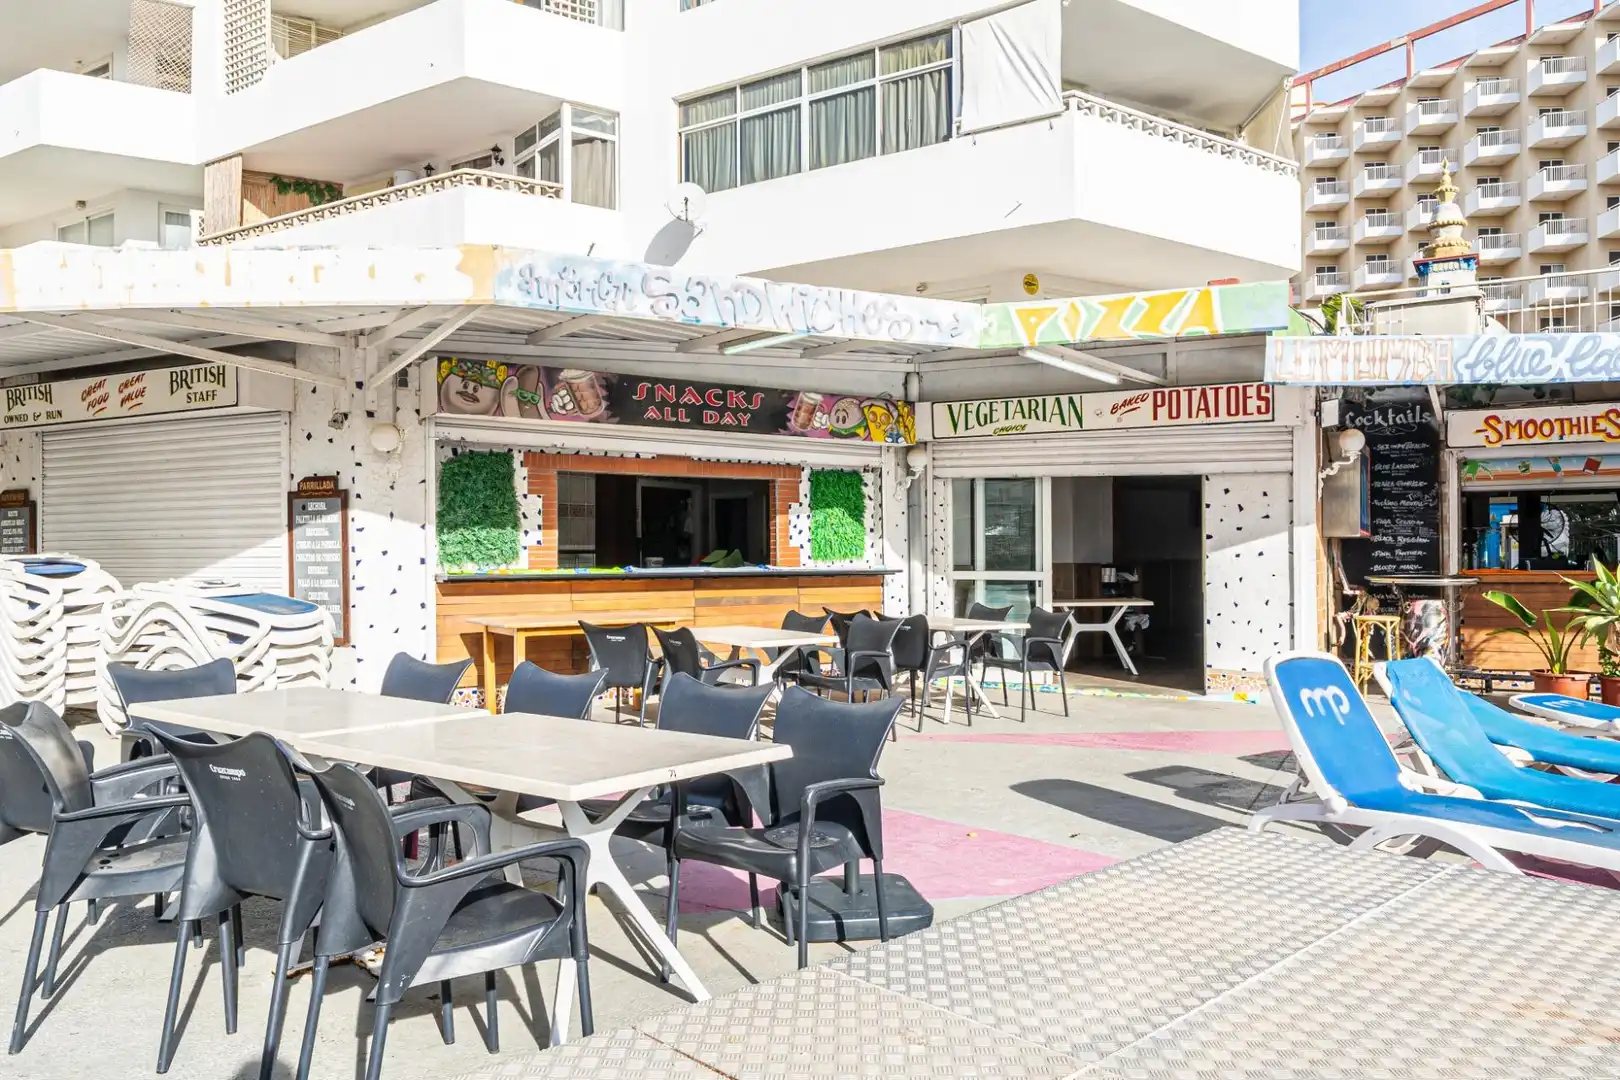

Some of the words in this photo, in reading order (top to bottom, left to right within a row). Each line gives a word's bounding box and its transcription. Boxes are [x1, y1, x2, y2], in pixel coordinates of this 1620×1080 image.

[1009, 287, 1224, 347] PIZZA
[81, 379, 108, 401] GREAT
[118, 373, 146, 393] GREAT
[169, 365, 226, 396] BRITISH
[6, 384, 53, 412] BRITISH
[87, 392, 110, 411] FOOD
[120, 387, 147, 407] VALUE
[186, 390, 218, 403] STAFF
[632, 382, 765, 410] SNACKS
[1110, 392, 1150, 415] BAKED
[1152, 384, 1272, 421] POTATOES
[4, 413, 29, 424] OWNED
[33, 412, 42, 421] &
[46, 410, 63, 420] RUN
[643, 405, 691, 422] ALL
[702, 410, 751, 426] DAY
[946, 395, 1084, 435] VEGETARIAN
[992, 424, 1027, 436] CHOICE
[300, 481, 335, 490] PARRILLADA
